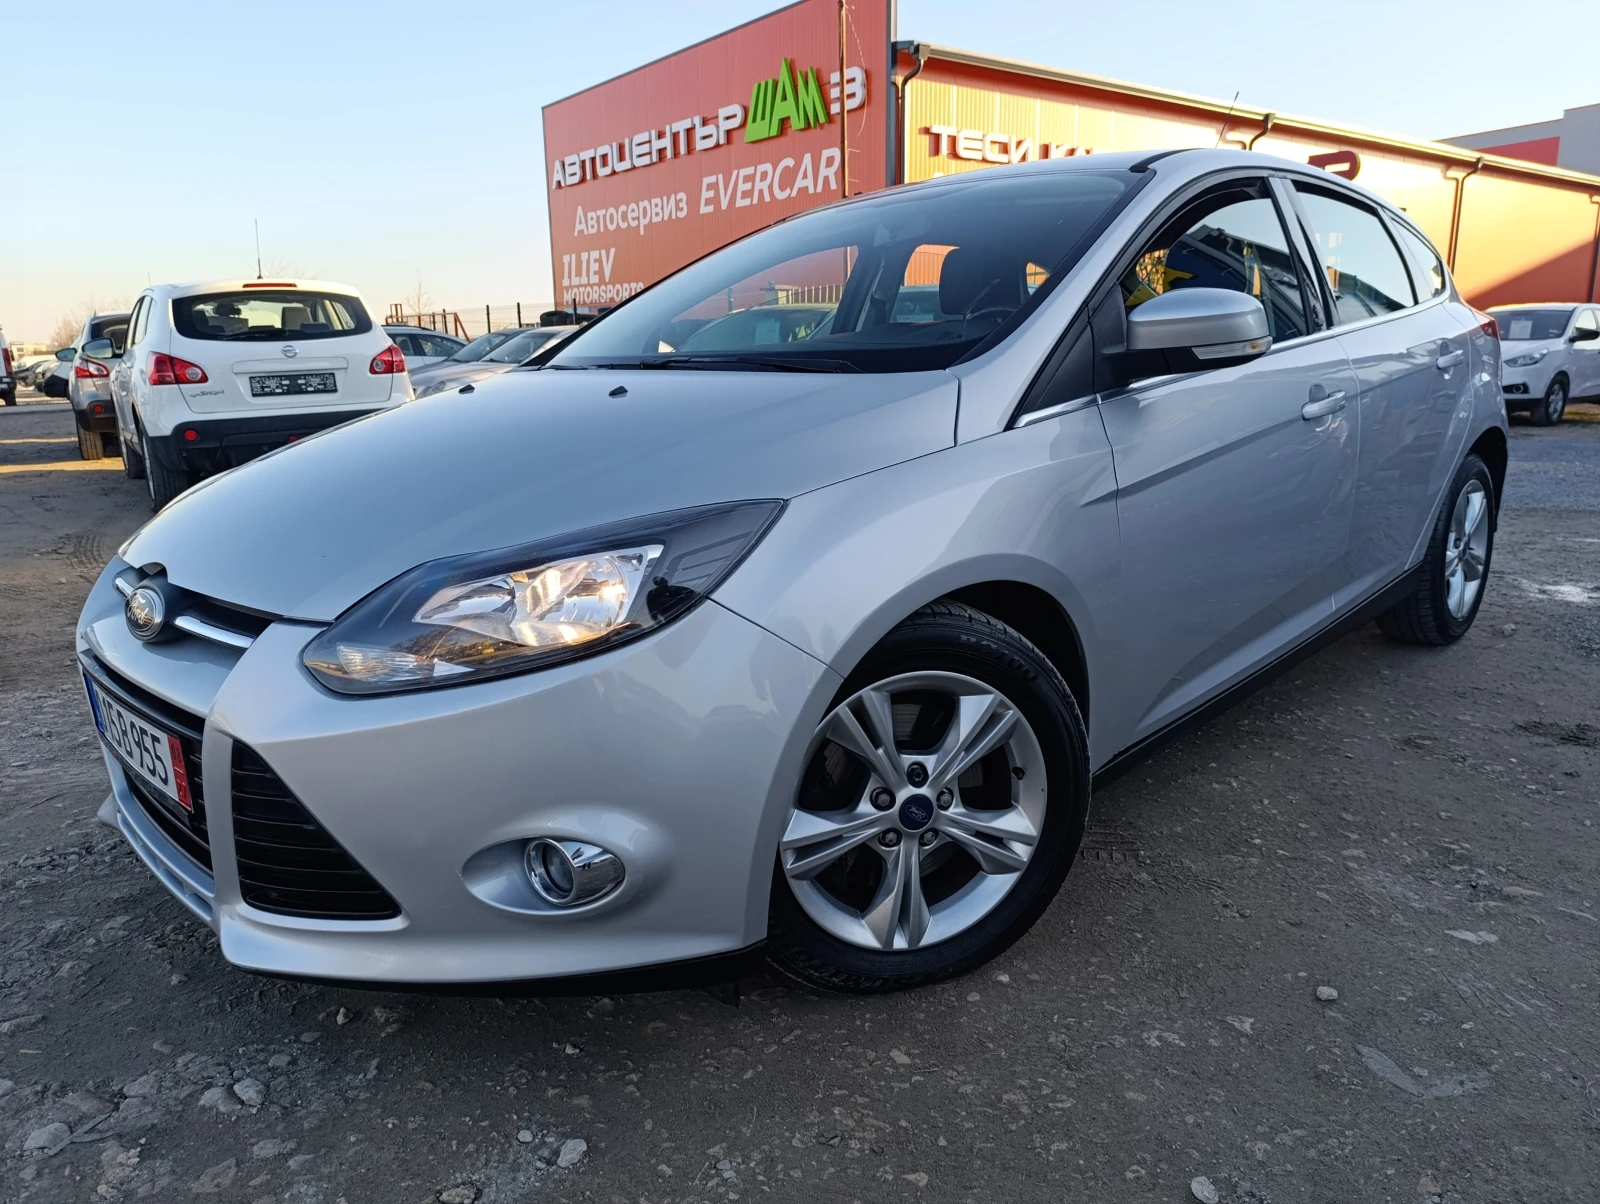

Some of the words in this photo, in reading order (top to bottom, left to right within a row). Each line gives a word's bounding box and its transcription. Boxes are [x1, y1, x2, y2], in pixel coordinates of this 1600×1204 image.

[552, 103, 745, 190] АВТОЦЕНТЪР
[744, 57, 829, 144] ШАМ
[929, 124, 1034, 165] ТЕСИ
[699, 147, 841, 215] EVERCAR
[574, 191, 688, 236] Автосервиз
[562, 247, 616, 287] ILIEV
